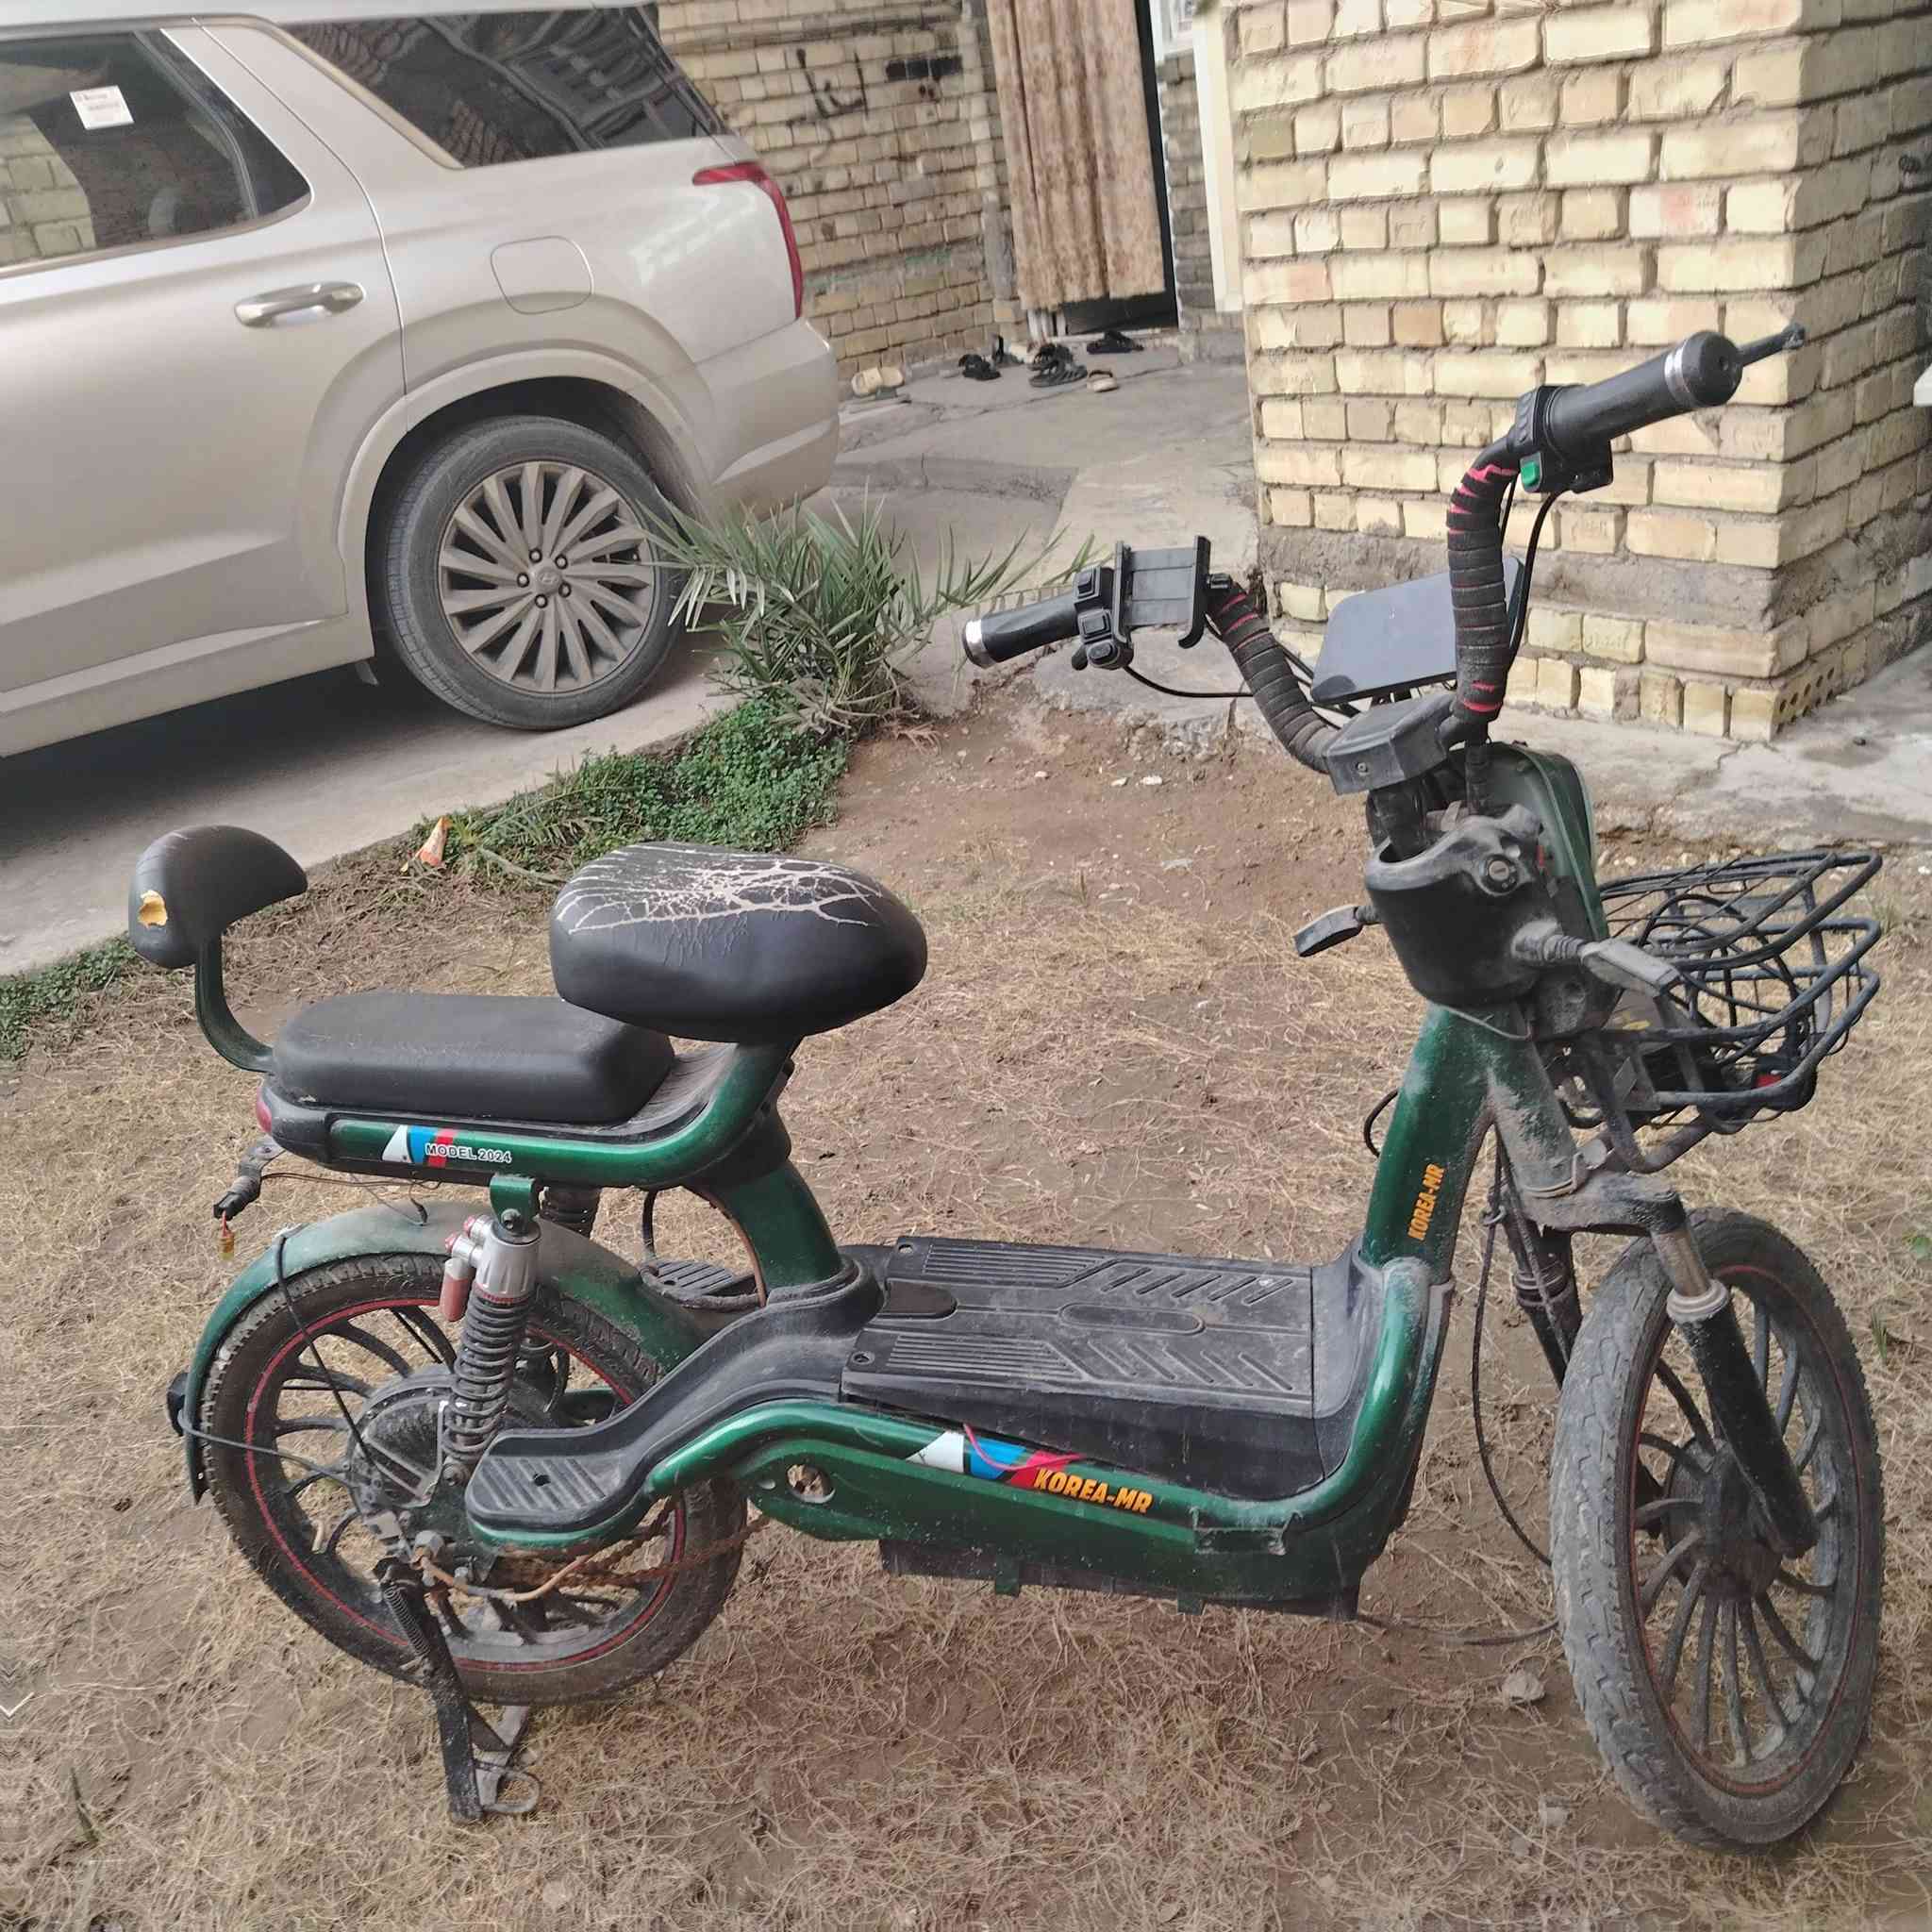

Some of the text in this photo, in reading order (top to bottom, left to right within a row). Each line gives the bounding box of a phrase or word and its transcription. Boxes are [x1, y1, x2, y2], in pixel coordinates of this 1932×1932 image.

[425, 1142, 512, 1164] MODEL 2024
[1407, 1163, 1445, 1241] KOREA-MR
[1033, 1467, 1154, 1514] KOREA-MR
